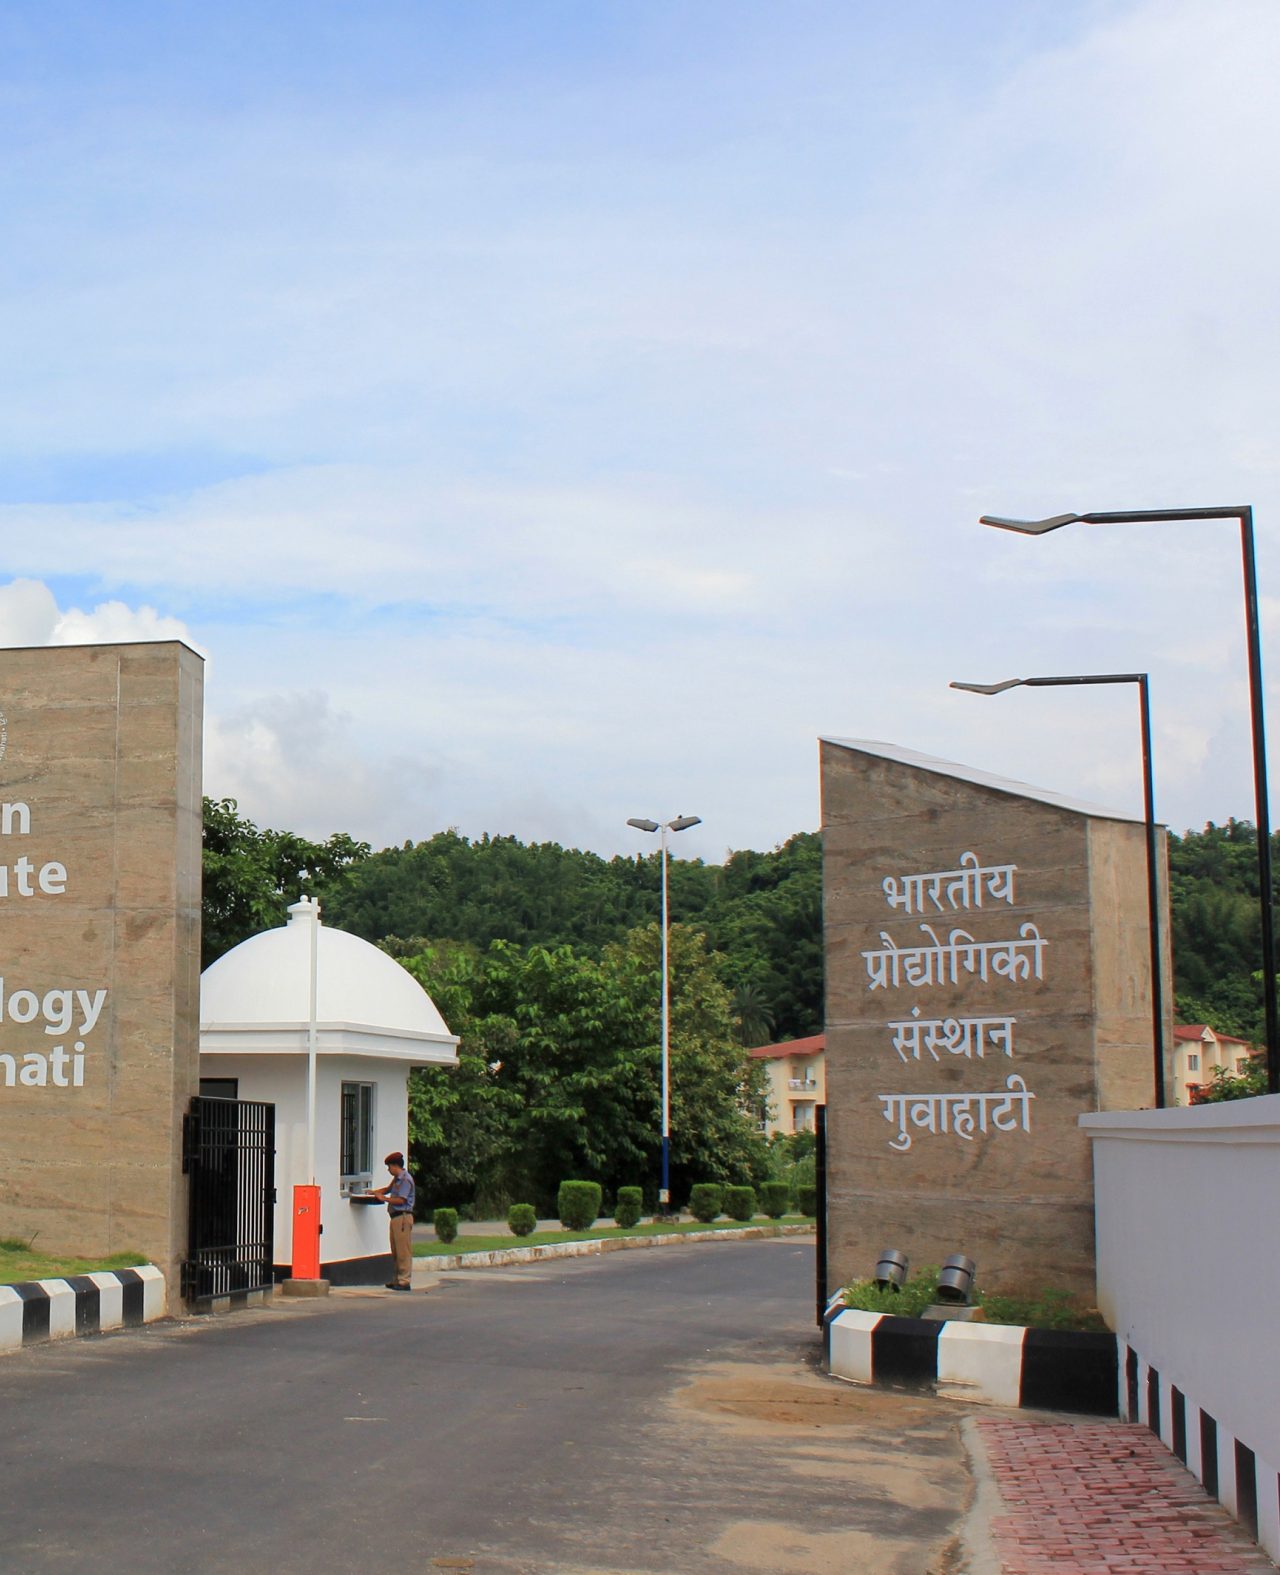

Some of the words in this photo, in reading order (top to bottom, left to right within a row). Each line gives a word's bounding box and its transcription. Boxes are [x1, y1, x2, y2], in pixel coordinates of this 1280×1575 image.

[882, 851, 1018, 914] भारतीय
[861, 922, 1049, 990] प्रौद्योगिकी
[887, 1006, 1018, 1063] संस्थान
[878, 1074, 1036, 1151] गुवाहाटी
